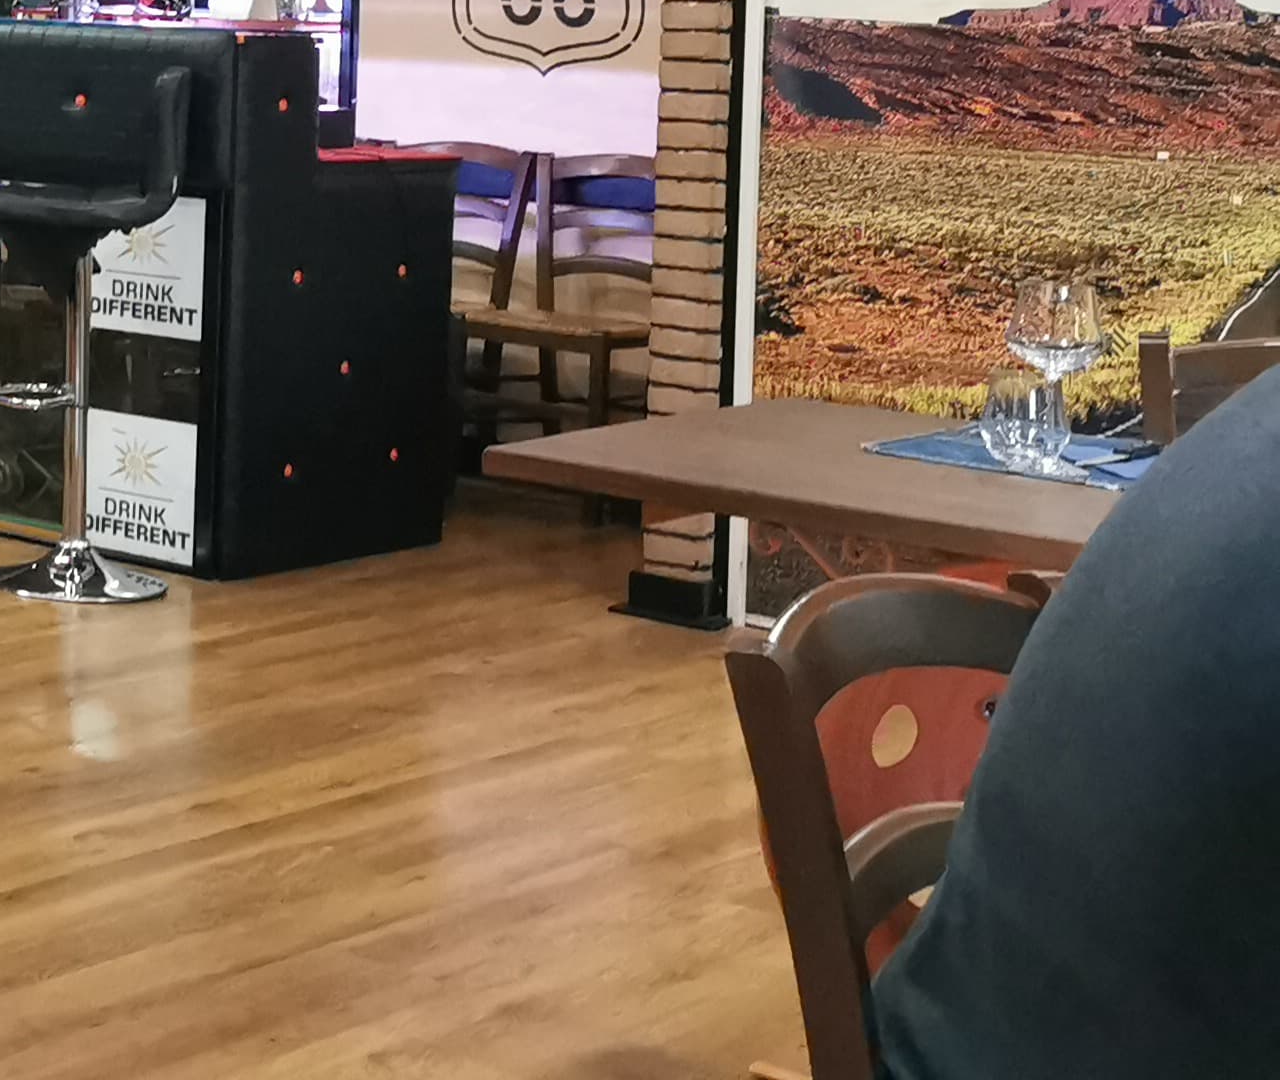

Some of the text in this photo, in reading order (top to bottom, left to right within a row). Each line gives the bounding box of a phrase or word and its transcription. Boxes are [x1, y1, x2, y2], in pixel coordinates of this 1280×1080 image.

[112, 279, 173, 304] DRINK
[91, 297, 197, 326] DIFFERENT
[104, 497, 166, 526] DRINK
[86, 514, 190, 550] DIFFERENT
